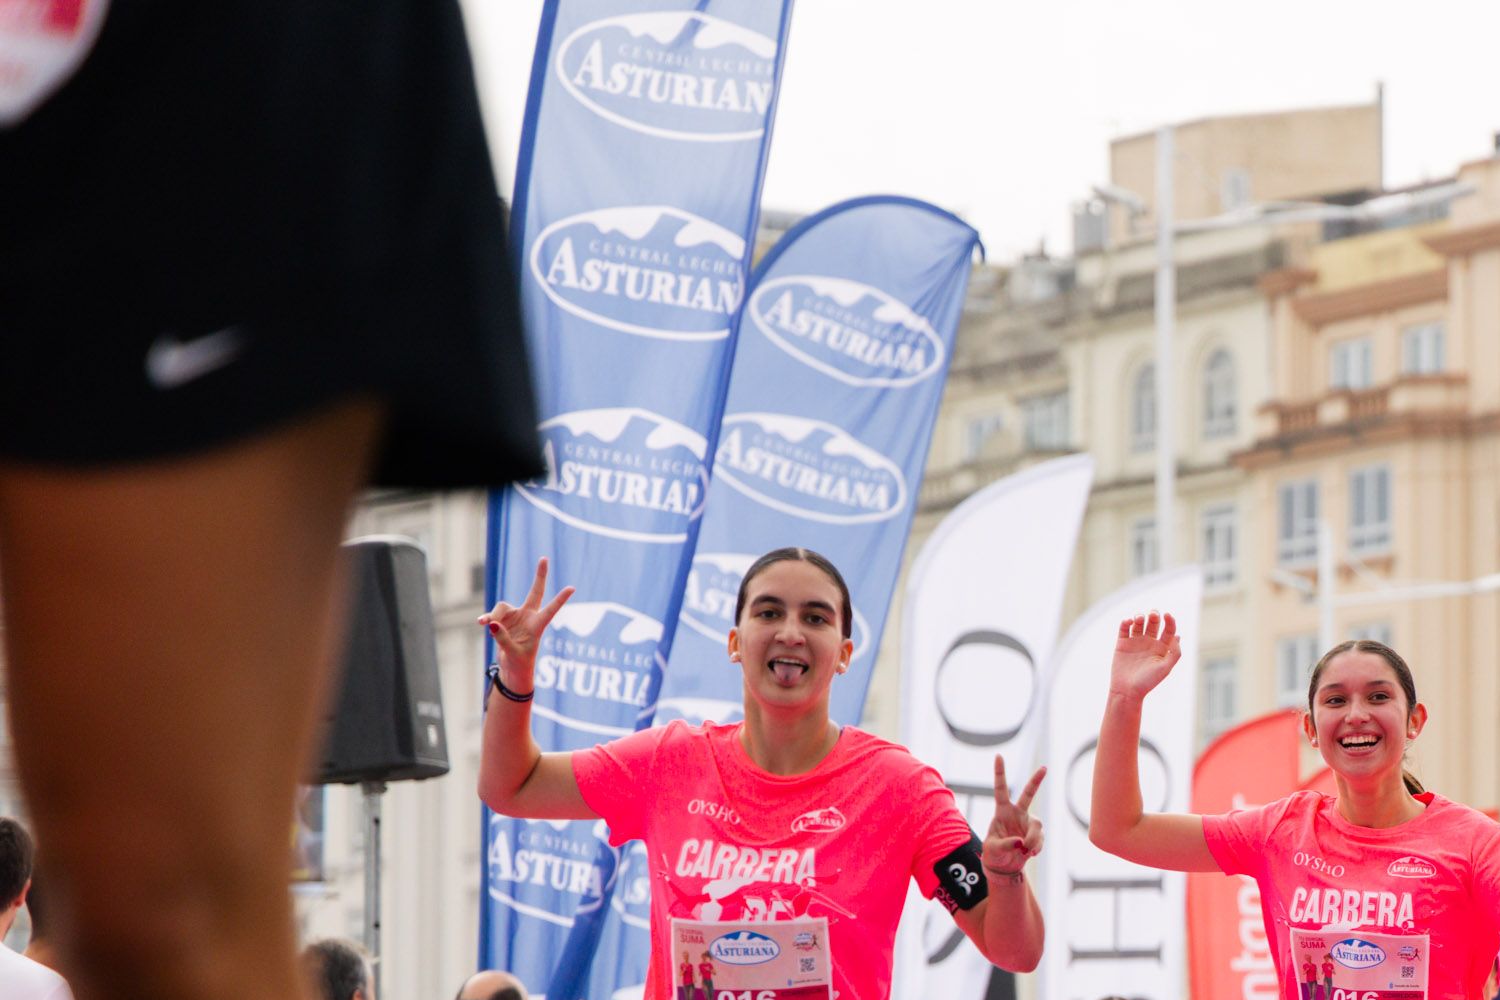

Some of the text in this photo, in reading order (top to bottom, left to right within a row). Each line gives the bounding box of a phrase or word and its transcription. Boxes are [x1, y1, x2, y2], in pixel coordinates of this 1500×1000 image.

[714, 427, 890, 512] ASTURIANA
[687, 798, 741, 826] OYSHO
[675, 838, 817, 887] CARRERA
[1293, 851, 1345, 878] OYSHO
[1289, 886, 1415, 929] CARRERA
[680, 934, 705, 945] SUMA
[714, 943, 775, 957] ASTURIANA
[1300, 941, 1326, 949] SUMA
[1335, 947, 1381, 962] ASTURIANA
